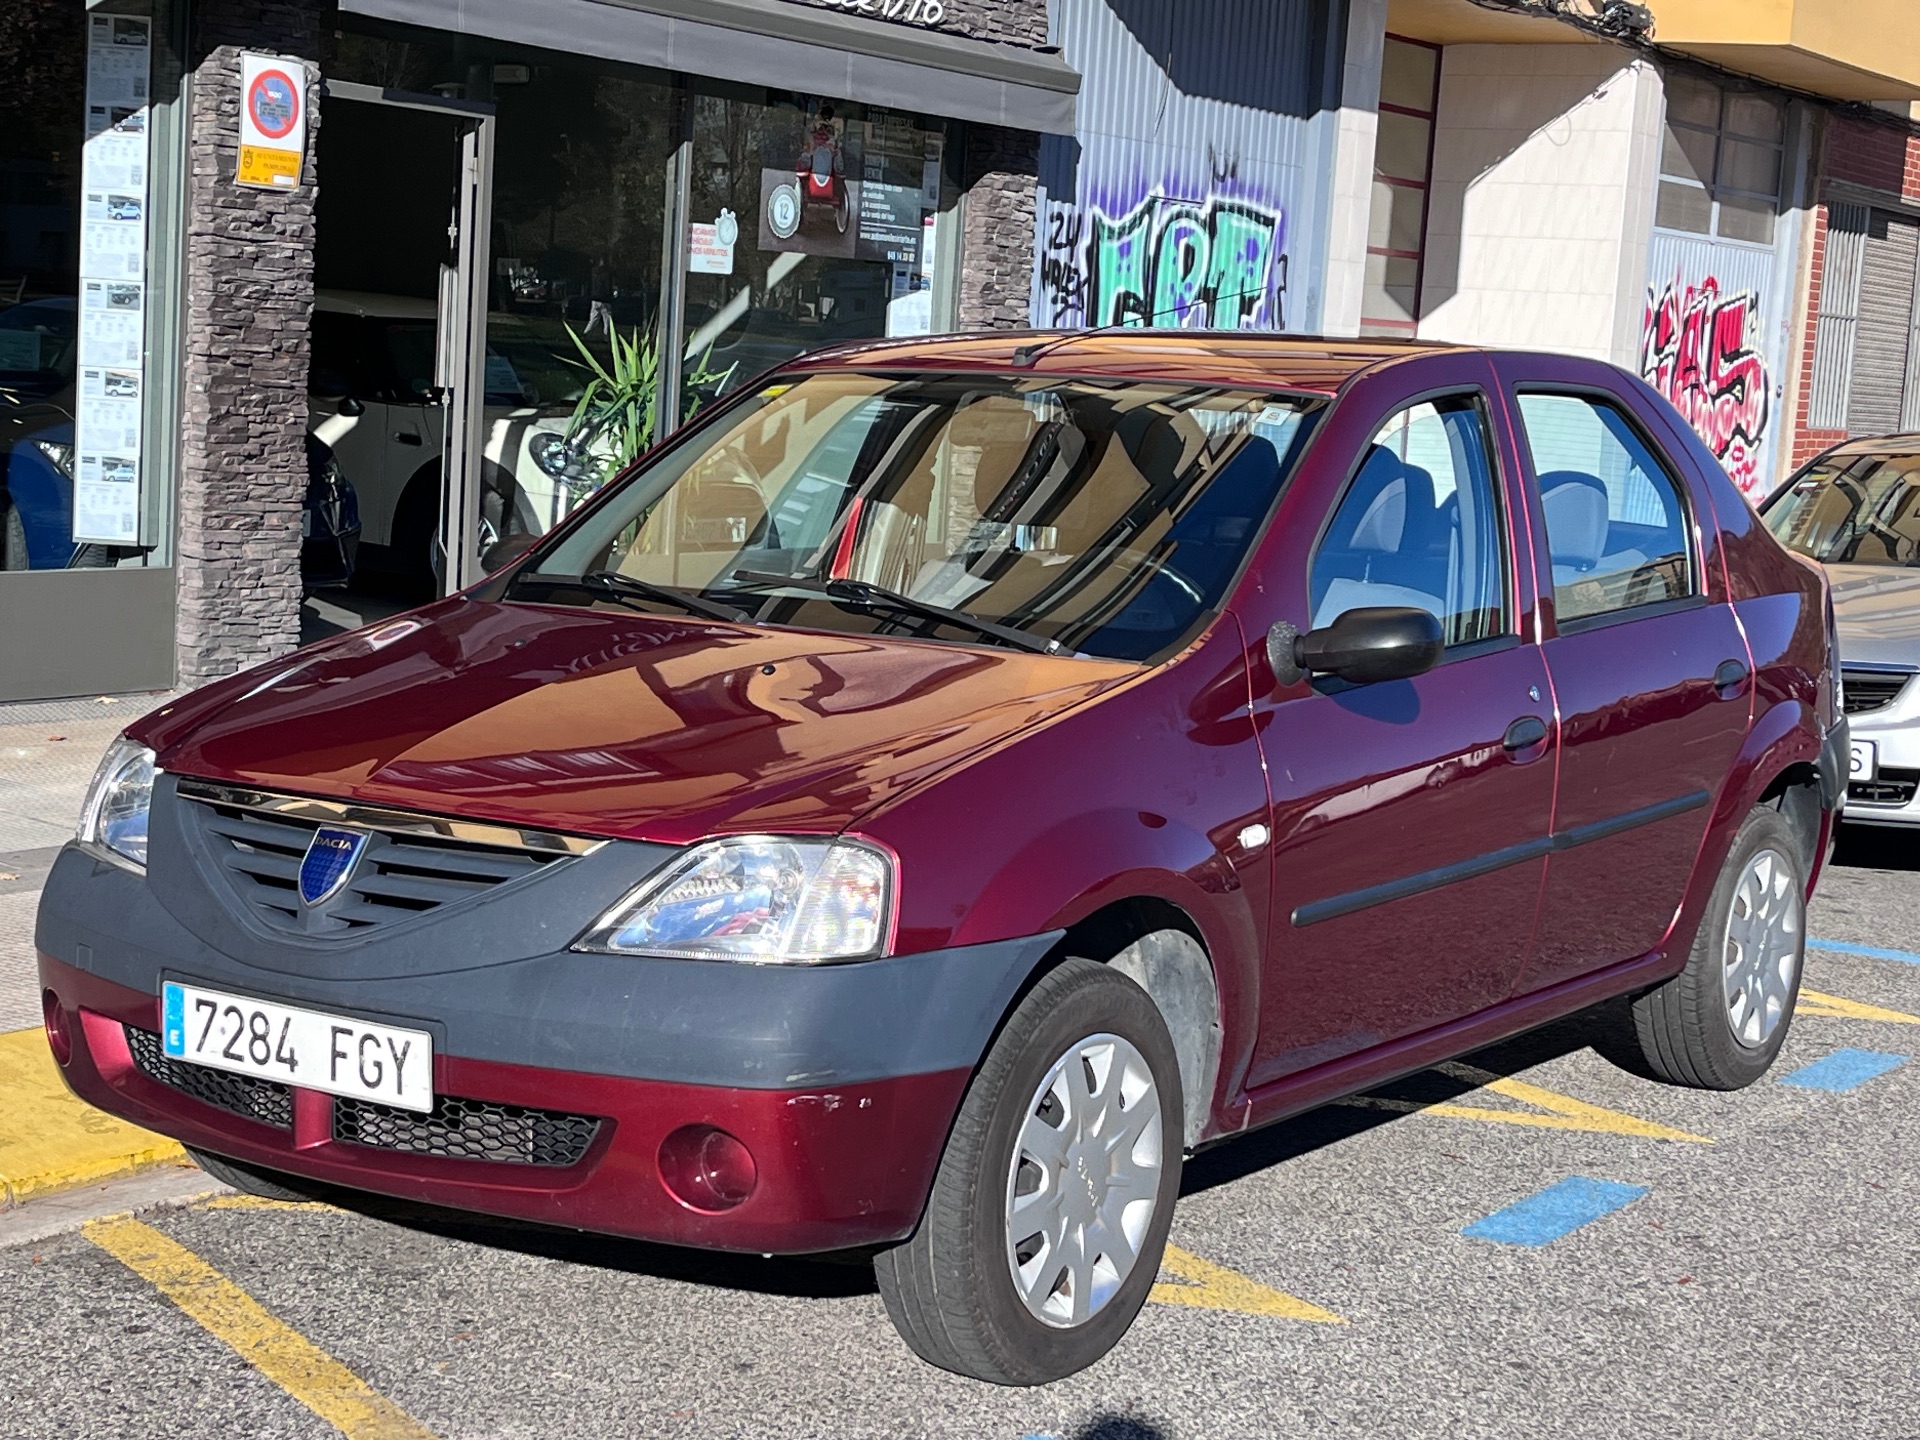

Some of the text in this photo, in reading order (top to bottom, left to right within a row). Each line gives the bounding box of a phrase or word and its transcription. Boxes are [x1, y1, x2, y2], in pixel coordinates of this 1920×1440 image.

[779, 202, 789, 220] 12
[315, 837, 352, 850] DACIA
[169, 1029, 180, 1046] E
[195, 997, 411, 1095] 7284 FGY
